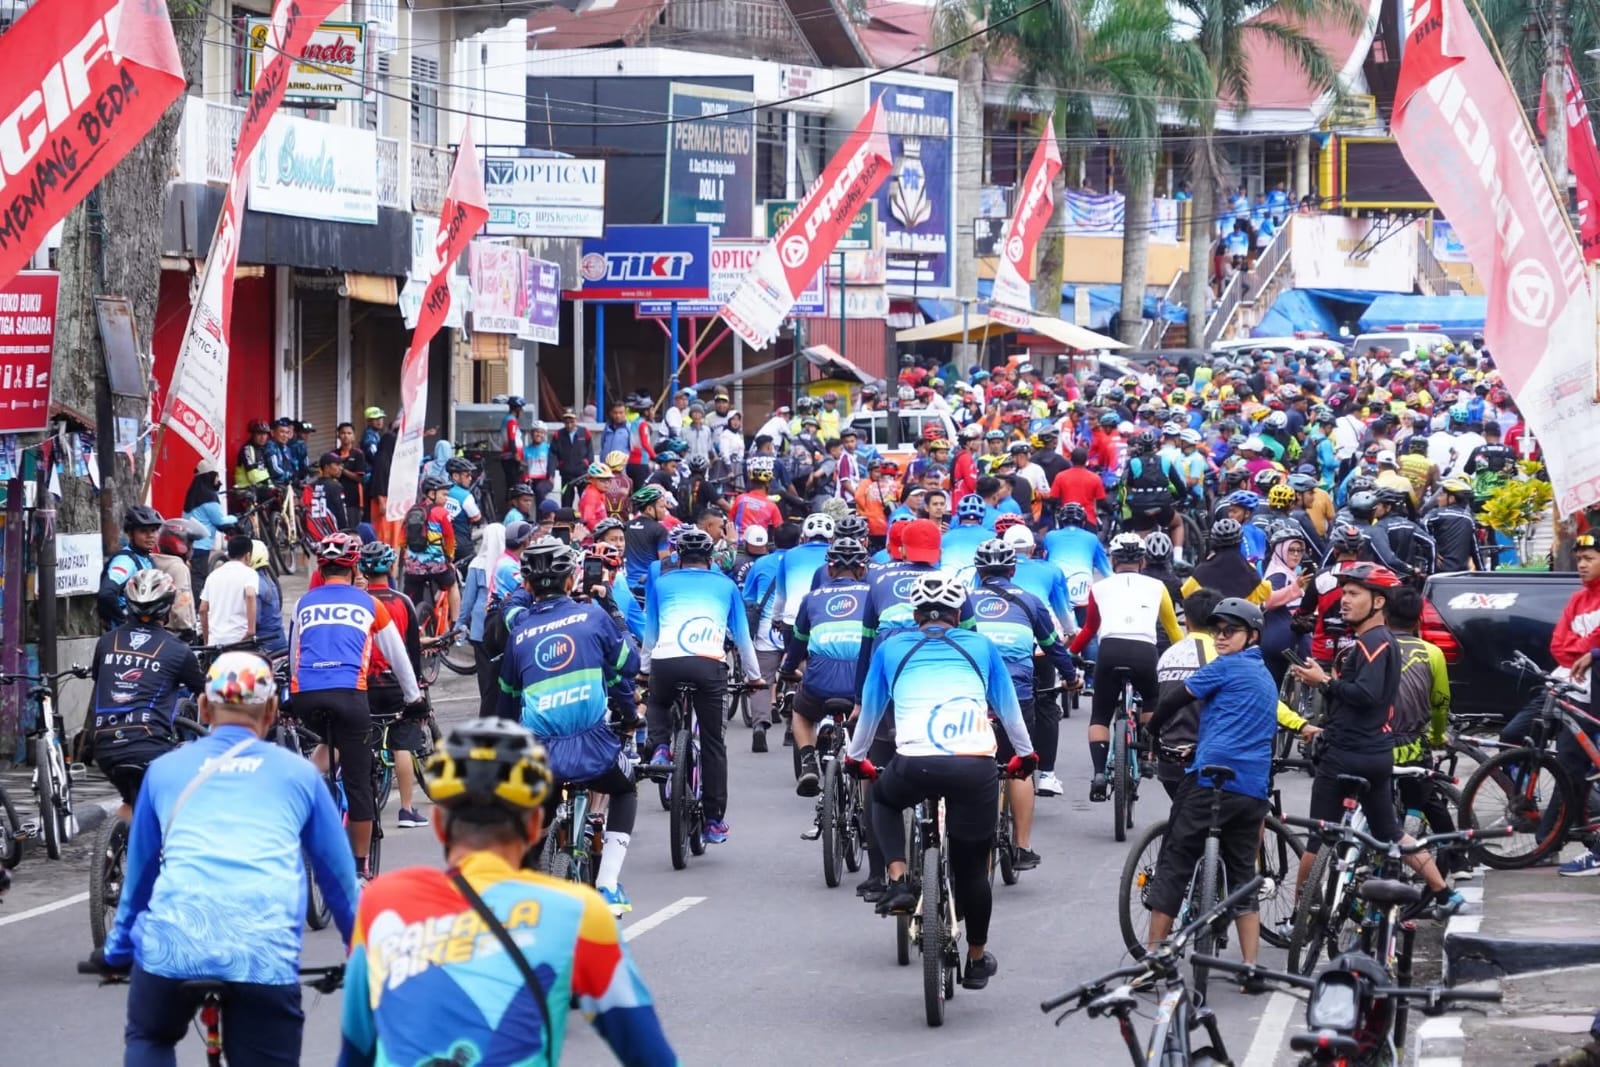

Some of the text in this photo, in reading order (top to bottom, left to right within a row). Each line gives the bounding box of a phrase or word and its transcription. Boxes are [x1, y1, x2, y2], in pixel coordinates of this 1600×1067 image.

[78, 65, 139, 146] BEDA
[674, 121, 750, 156] PERMATA RENO
[20, 293, 42, 312] BUKU
[16, 316, 51, 335] SAUDARA
[300, 605, 366, 629] BNCC
[515, 612, 588, 645] D'STRIKER
[104, 653, 161, 672] MYSTIC
[541, 641, 569, 664] ollin
[538, 684, 593, 712] BNCC
[95, 711, 151, 727] BONE
